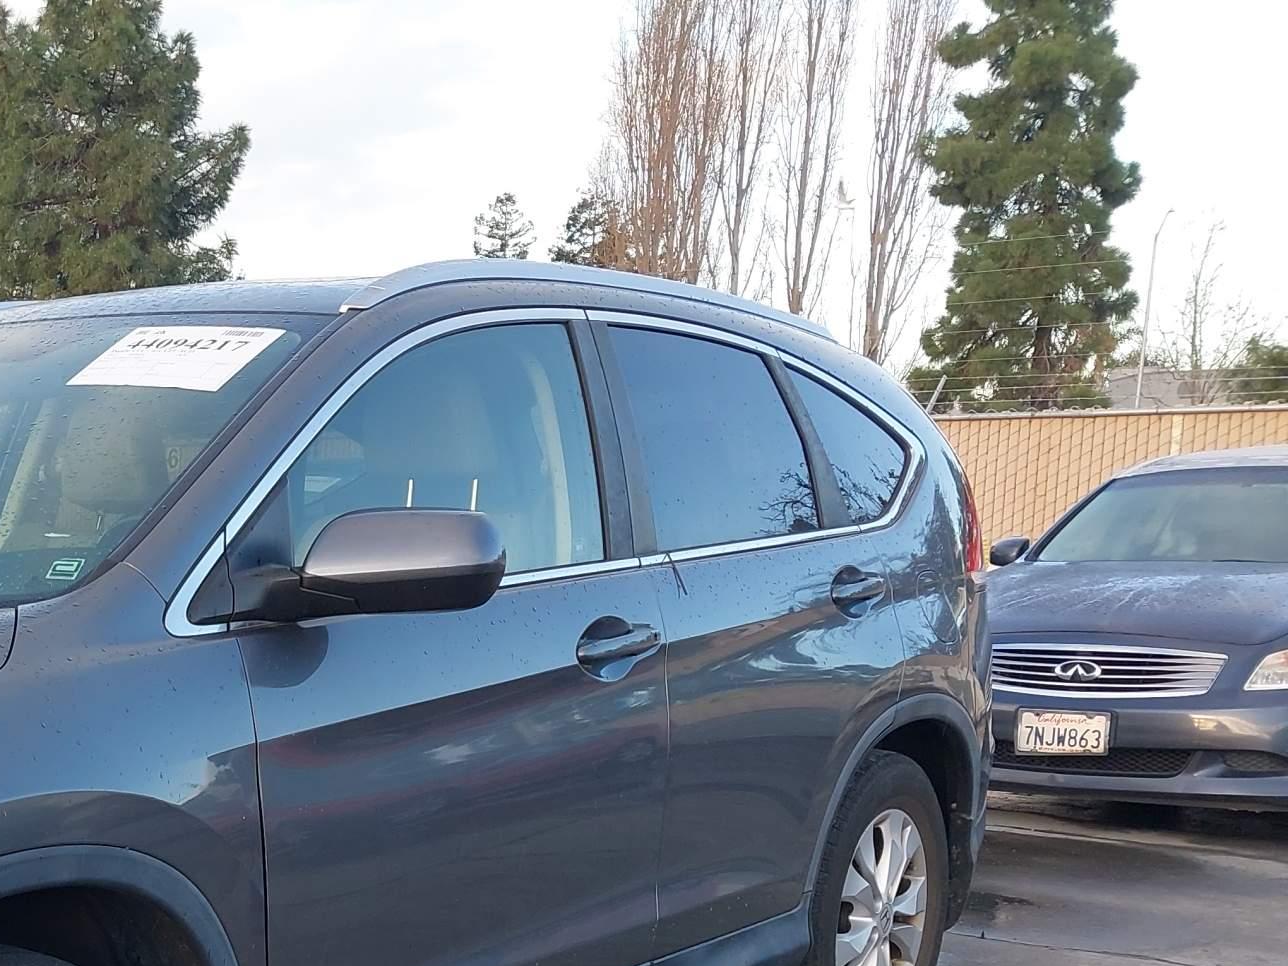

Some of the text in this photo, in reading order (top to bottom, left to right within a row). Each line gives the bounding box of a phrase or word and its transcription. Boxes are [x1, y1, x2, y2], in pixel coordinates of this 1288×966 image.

[127, 338, 251, 352] 44094217
[1037, 712, 1088, 726] California
[1024, 725, 1102, 749] 7NJW863
